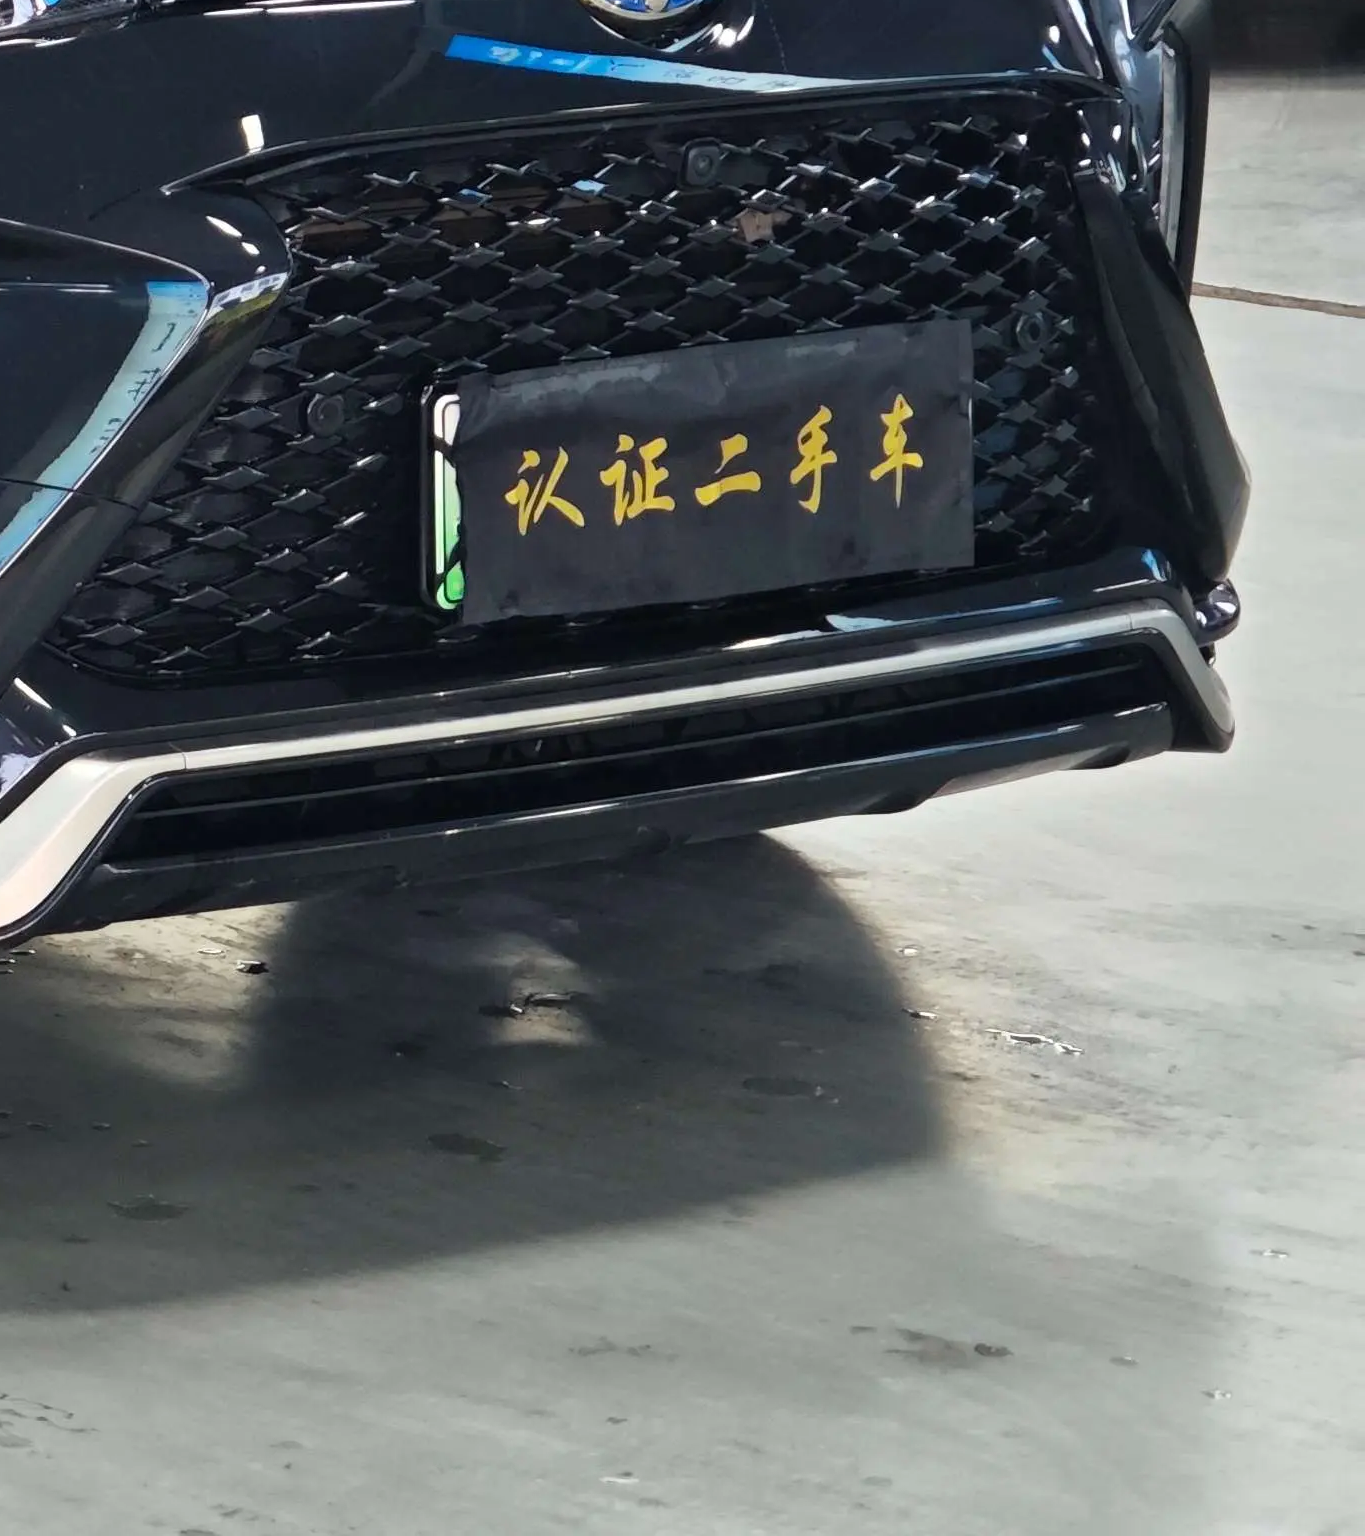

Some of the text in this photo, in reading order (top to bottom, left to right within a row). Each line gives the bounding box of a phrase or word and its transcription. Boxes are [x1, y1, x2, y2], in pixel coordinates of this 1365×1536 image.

[504, 393, 924, 536] 认证二手车
